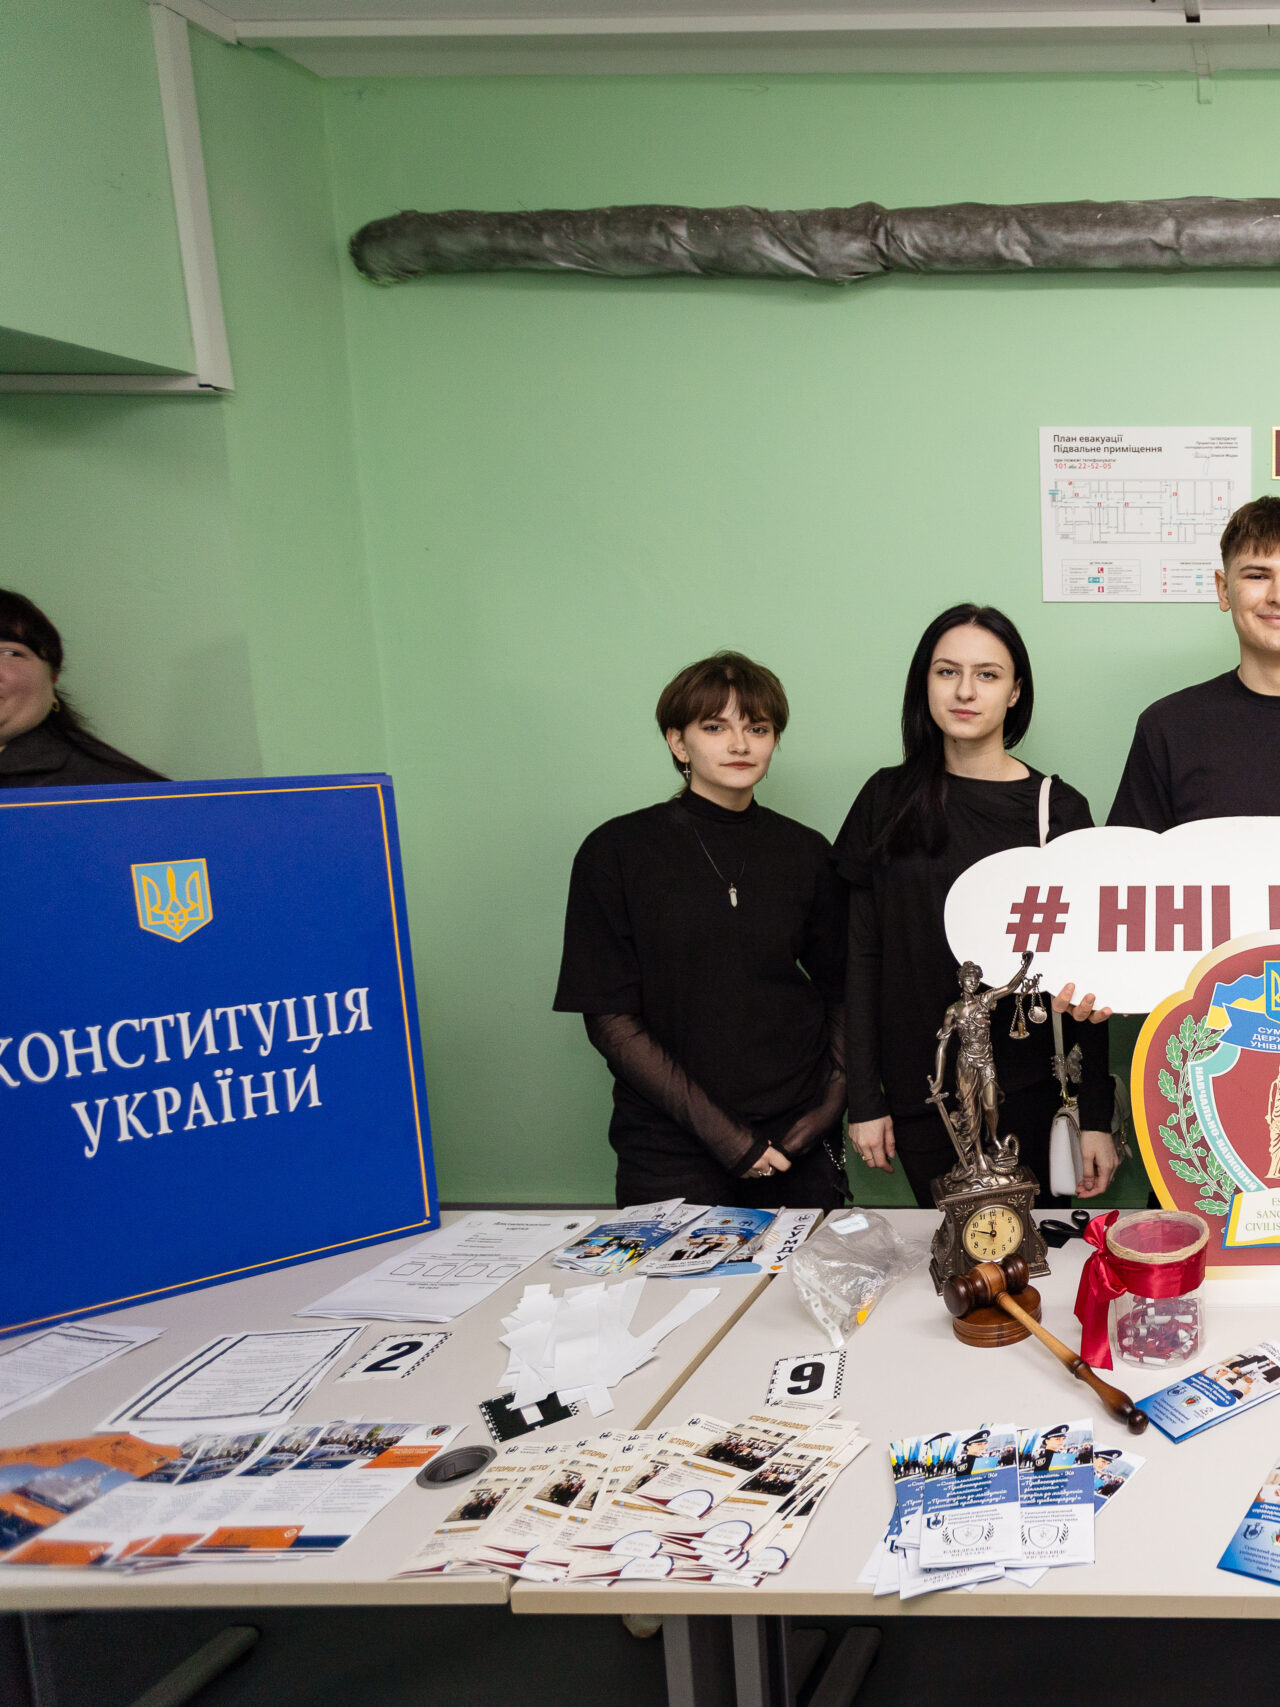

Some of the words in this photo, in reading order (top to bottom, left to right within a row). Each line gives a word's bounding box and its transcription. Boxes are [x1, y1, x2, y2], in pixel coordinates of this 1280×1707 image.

[1053, 435, 1077, 443] План
[1079, 435, 1123, 445] евакуації
[1053, 445, 1102, 456] Підвальне
[1103, 445, 1163, 455] приміщення
[1099, 885, 1231, 952] ННІ
[71, 1064, 322, 1159] УКРАЇНИ
[362, 1341, 424, 1373] 2
[786, 1361, 826, 1396] 9
